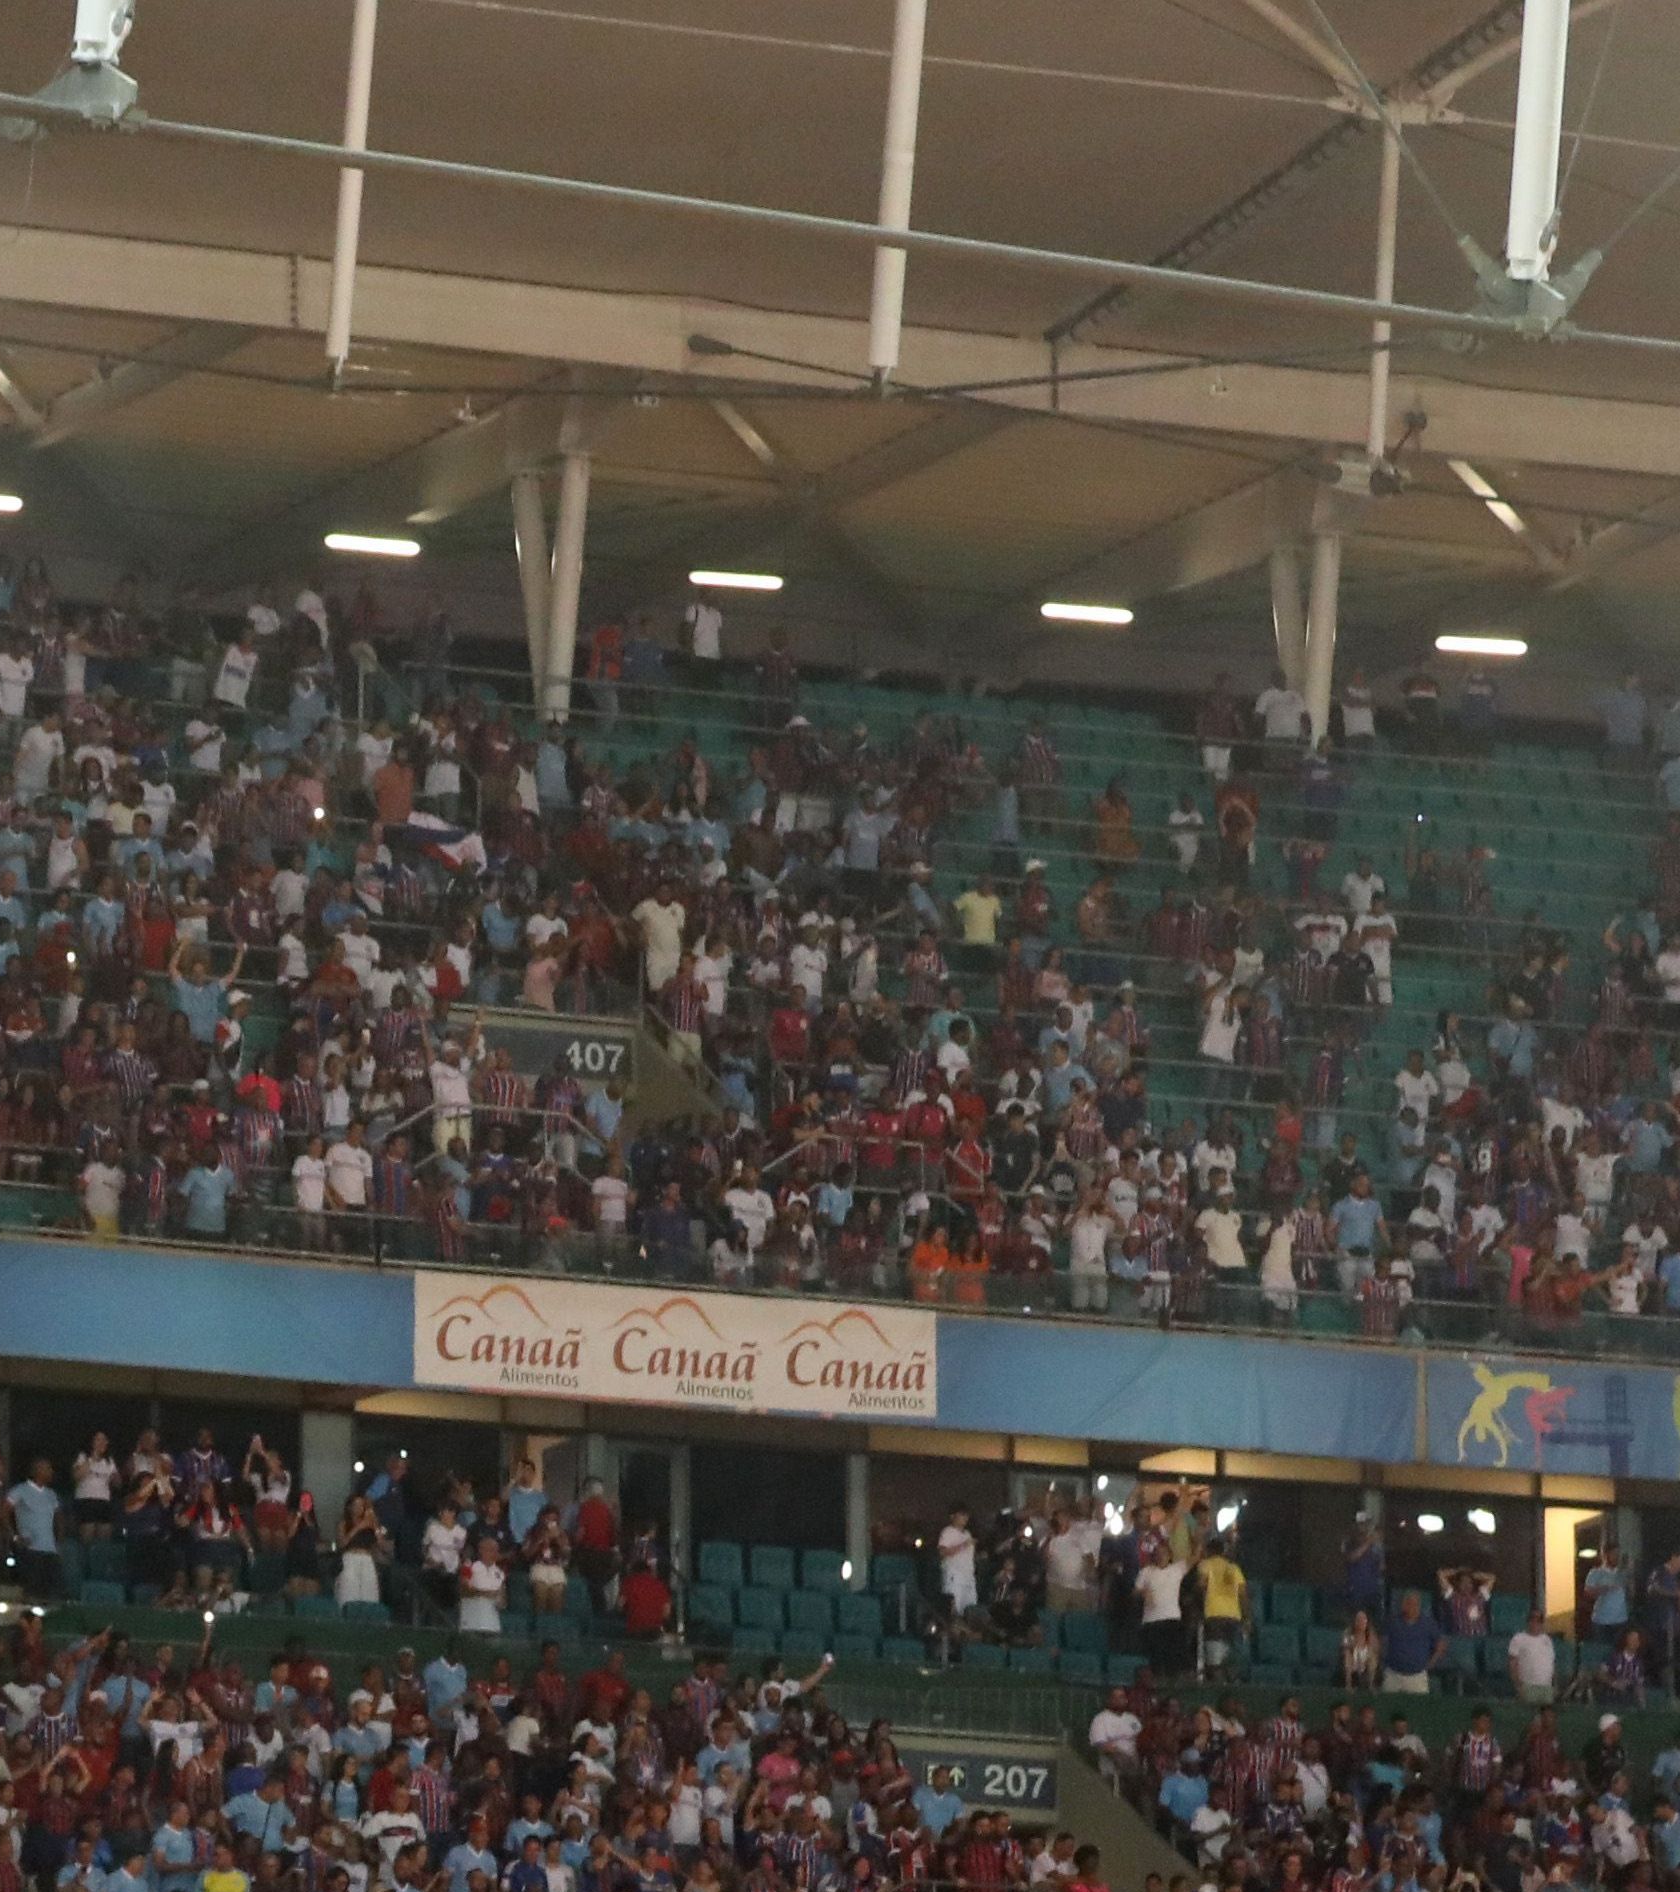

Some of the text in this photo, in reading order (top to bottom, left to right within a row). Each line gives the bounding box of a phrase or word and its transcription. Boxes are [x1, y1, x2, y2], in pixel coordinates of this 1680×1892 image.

[435, 1312, 586, 1370] Canaã
[612, 1324, 760, 1383] Canaã
[498, 1367, 580, 1390] Alimentos
[785, 1336, 929, 1393] Canaã
[675, 1379, 756, 1402] Alimentos
[847, 1390, 927, 1412] Alimentos
[983, 1762, 1050, 1801] 207
